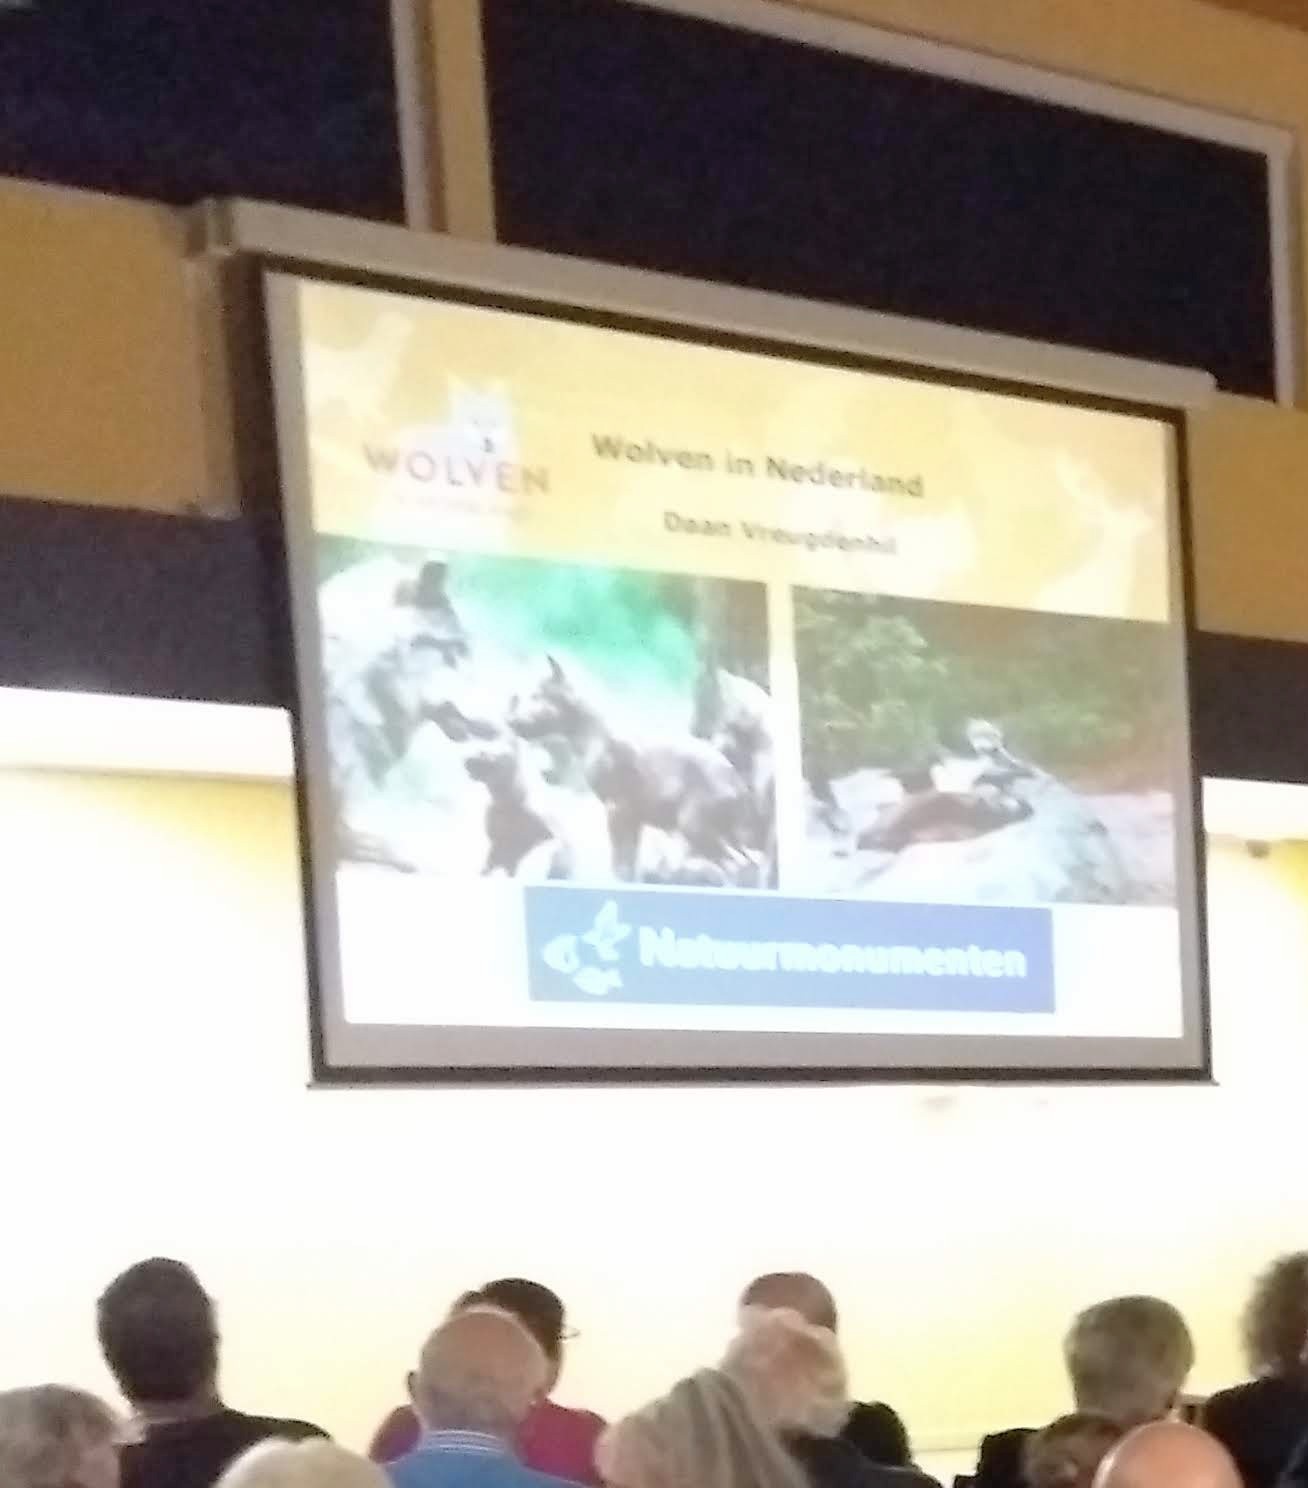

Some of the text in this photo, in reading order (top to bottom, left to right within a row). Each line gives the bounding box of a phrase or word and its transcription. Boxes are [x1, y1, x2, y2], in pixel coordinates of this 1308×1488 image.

[362, 442, 552, 496] WOLVEN
[591, 433, 923, 499] Wolven in Nederland
[664, 511, 731, 537] Daan
[638, 925, 1028, 979] Natuurmonumenten
